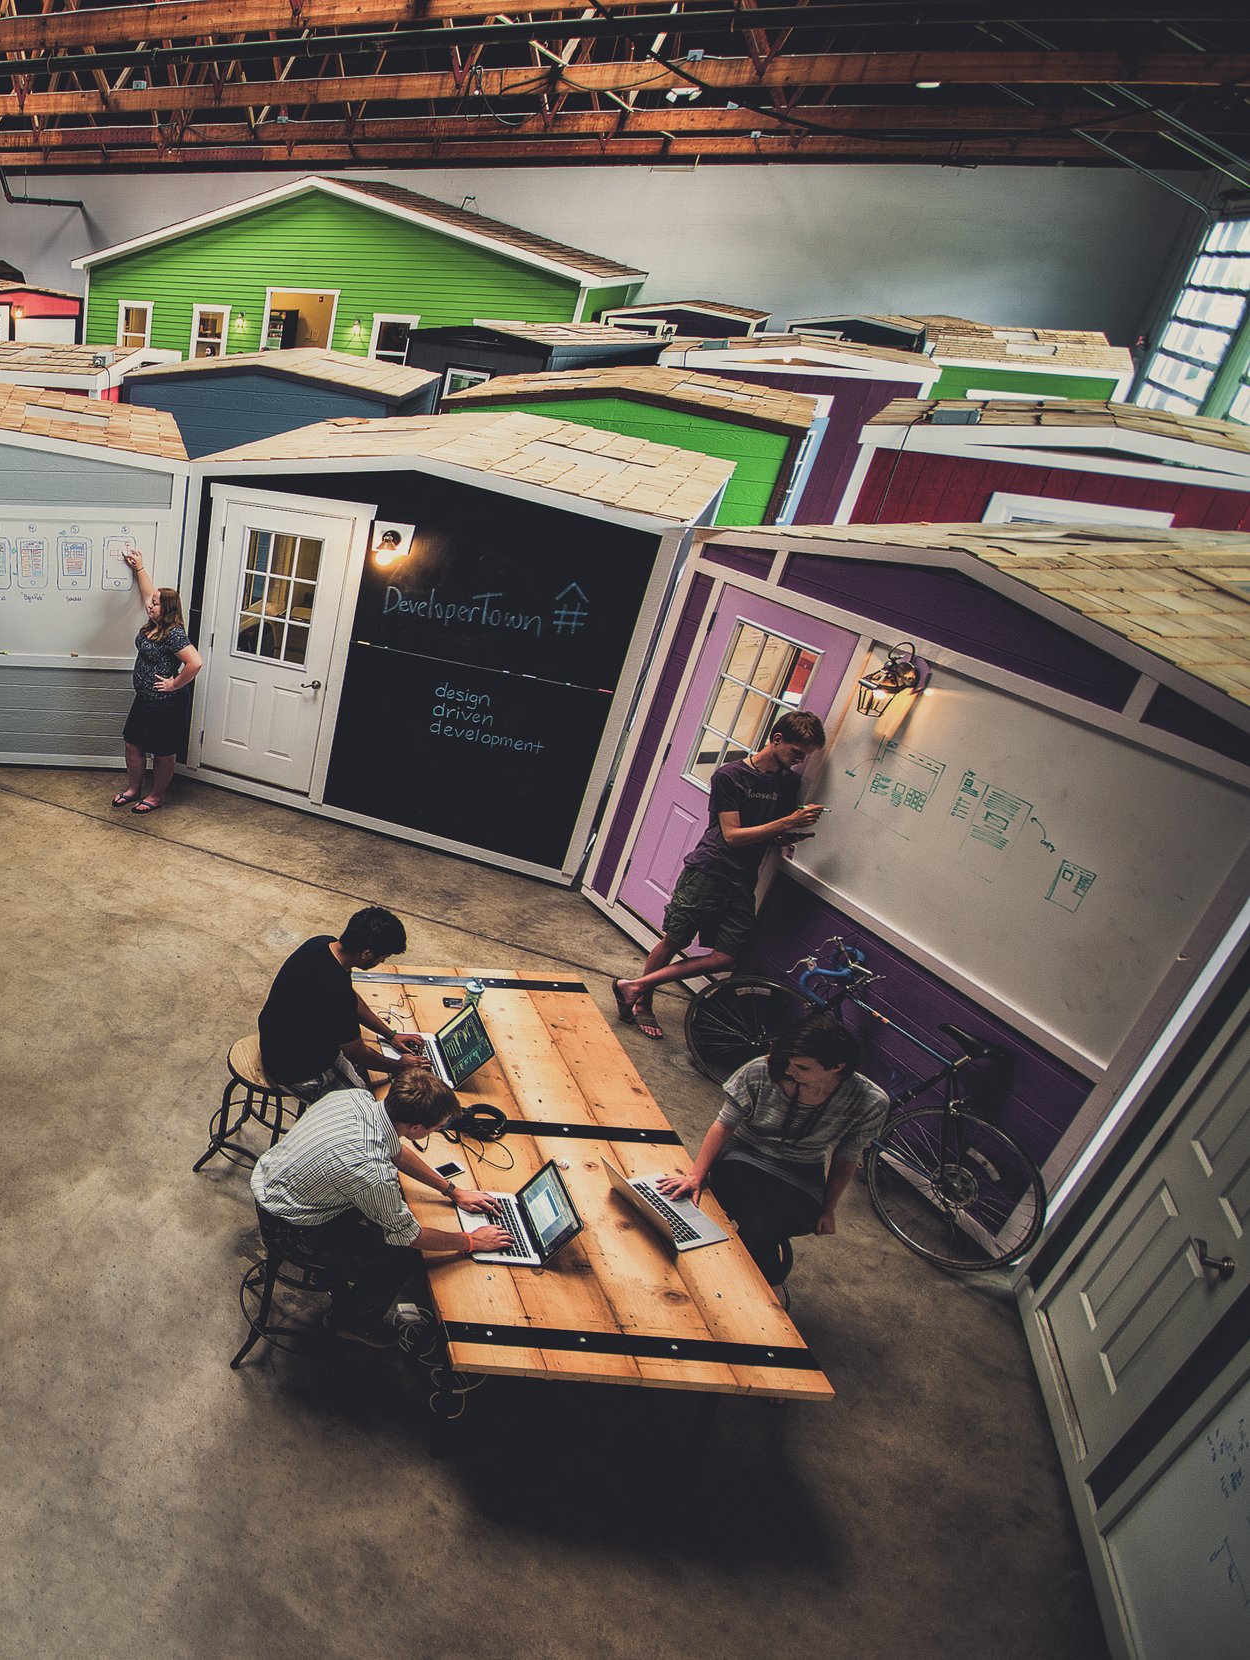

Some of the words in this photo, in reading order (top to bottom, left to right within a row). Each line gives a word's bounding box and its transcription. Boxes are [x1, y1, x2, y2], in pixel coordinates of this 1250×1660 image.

[382, 584, 543, 637] DeveloperTown
[434, 682, 490, 709] design
[432, 703, 494, 727] driven
[429, 720, 546, 755] development
